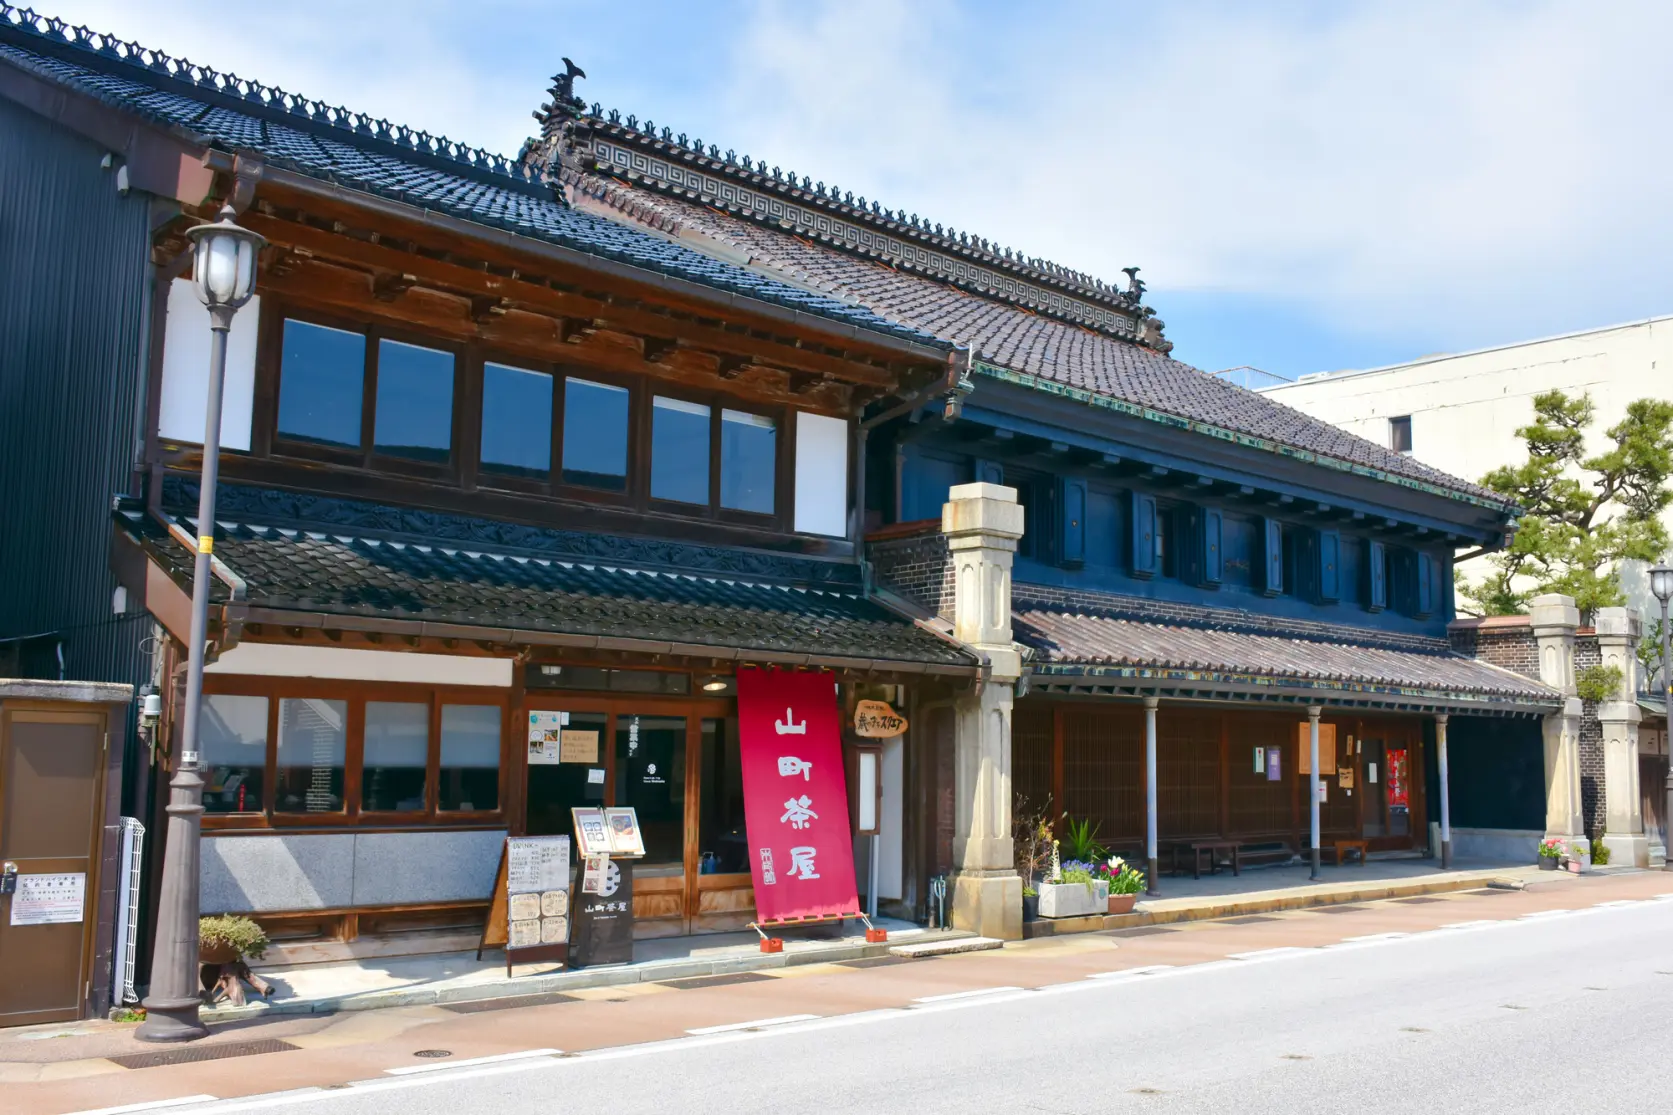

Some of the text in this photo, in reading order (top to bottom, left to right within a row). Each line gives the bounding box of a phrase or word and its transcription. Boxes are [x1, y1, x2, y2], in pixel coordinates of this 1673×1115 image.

[774, 706, 820, 880] 山町茶屋
[584, 902, 627, 914] 山町茶屋
